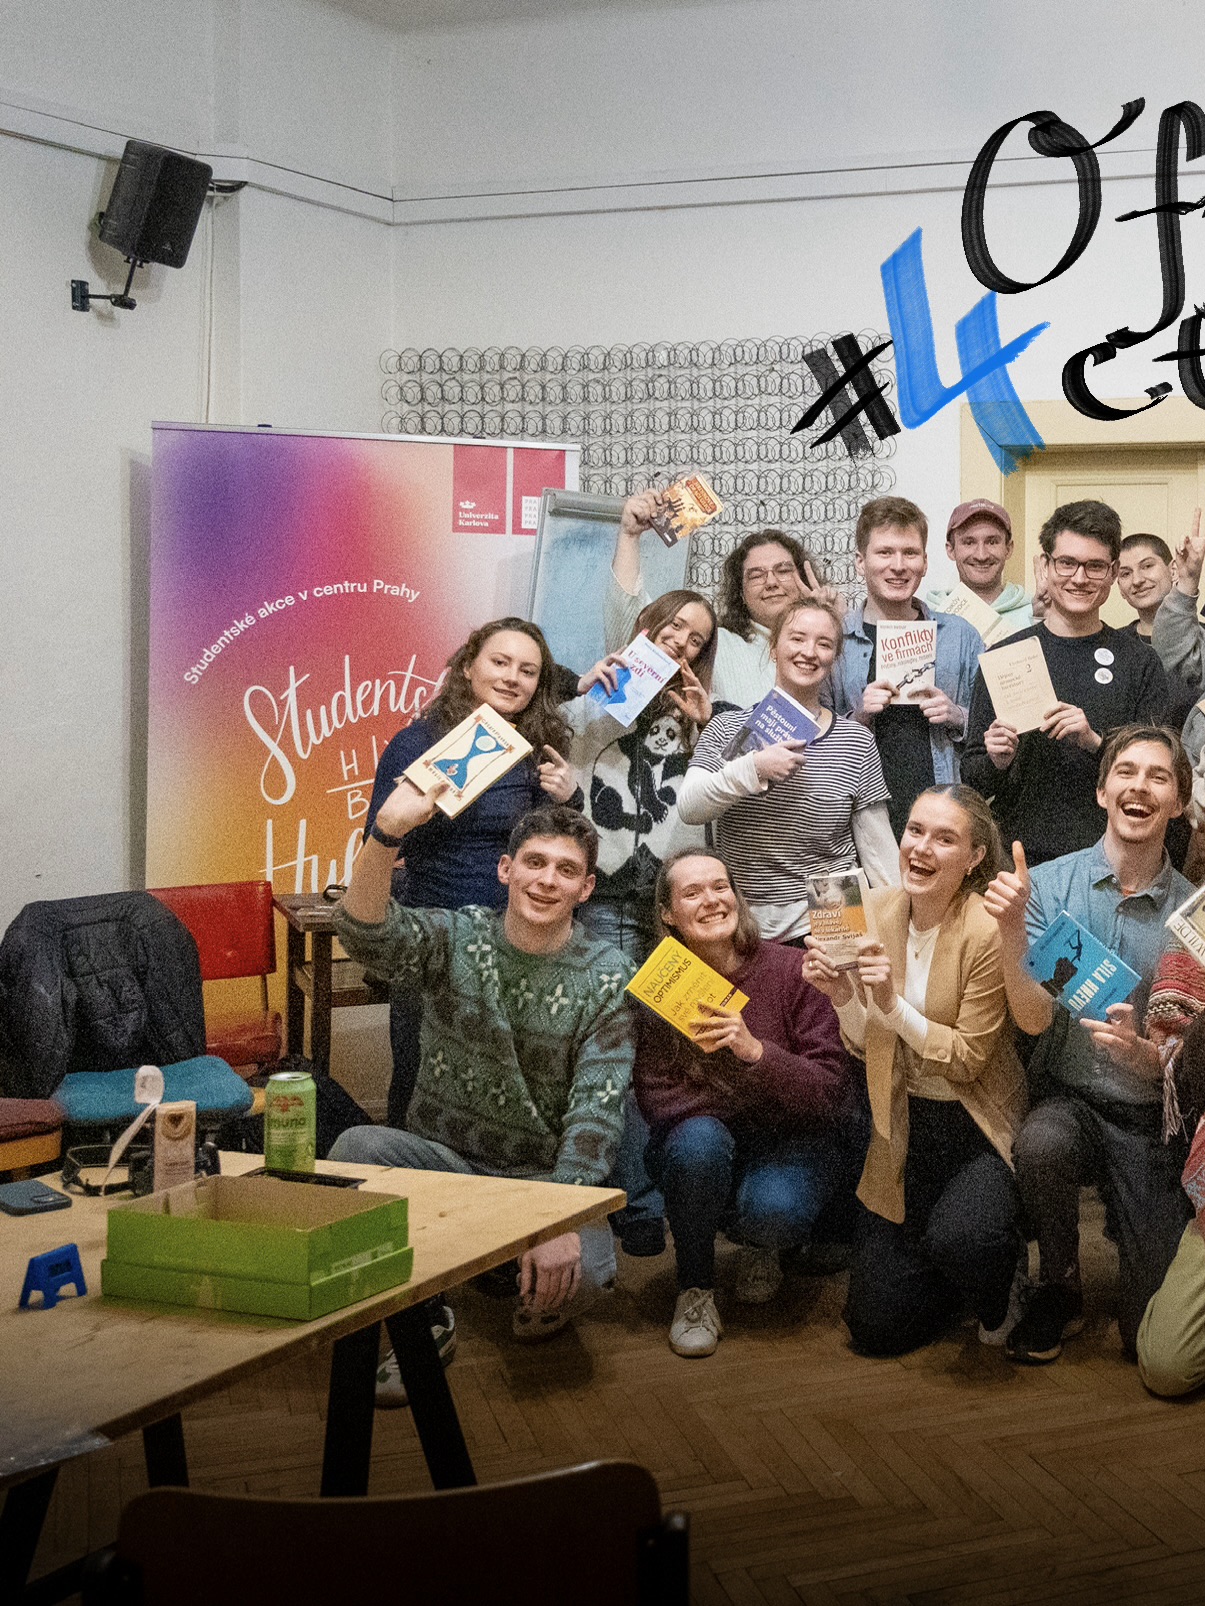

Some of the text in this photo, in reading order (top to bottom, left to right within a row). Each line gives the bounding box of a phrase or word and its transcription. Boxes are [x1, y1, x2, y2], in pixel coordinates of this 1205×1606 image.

[459, 511, 499, 520] Univerzita
[183, 579, 420, 685] Studentské akce v centru Prahy
[881, 628, 934, 651] Konflikty
[881, 642, 933, 663] ve firmách
[1026, 663, 1032, 674] 2
[755, 719, 765, 730] na
[760, 712, 777, 728] mají
[766, 705, 797, 733] Pěstouni
[643, 949, 682, 998] NAUČENÝ
[653, 957, 692, 1004] OPTIMISMUS
[671, 999, 684, 1016] Jak
